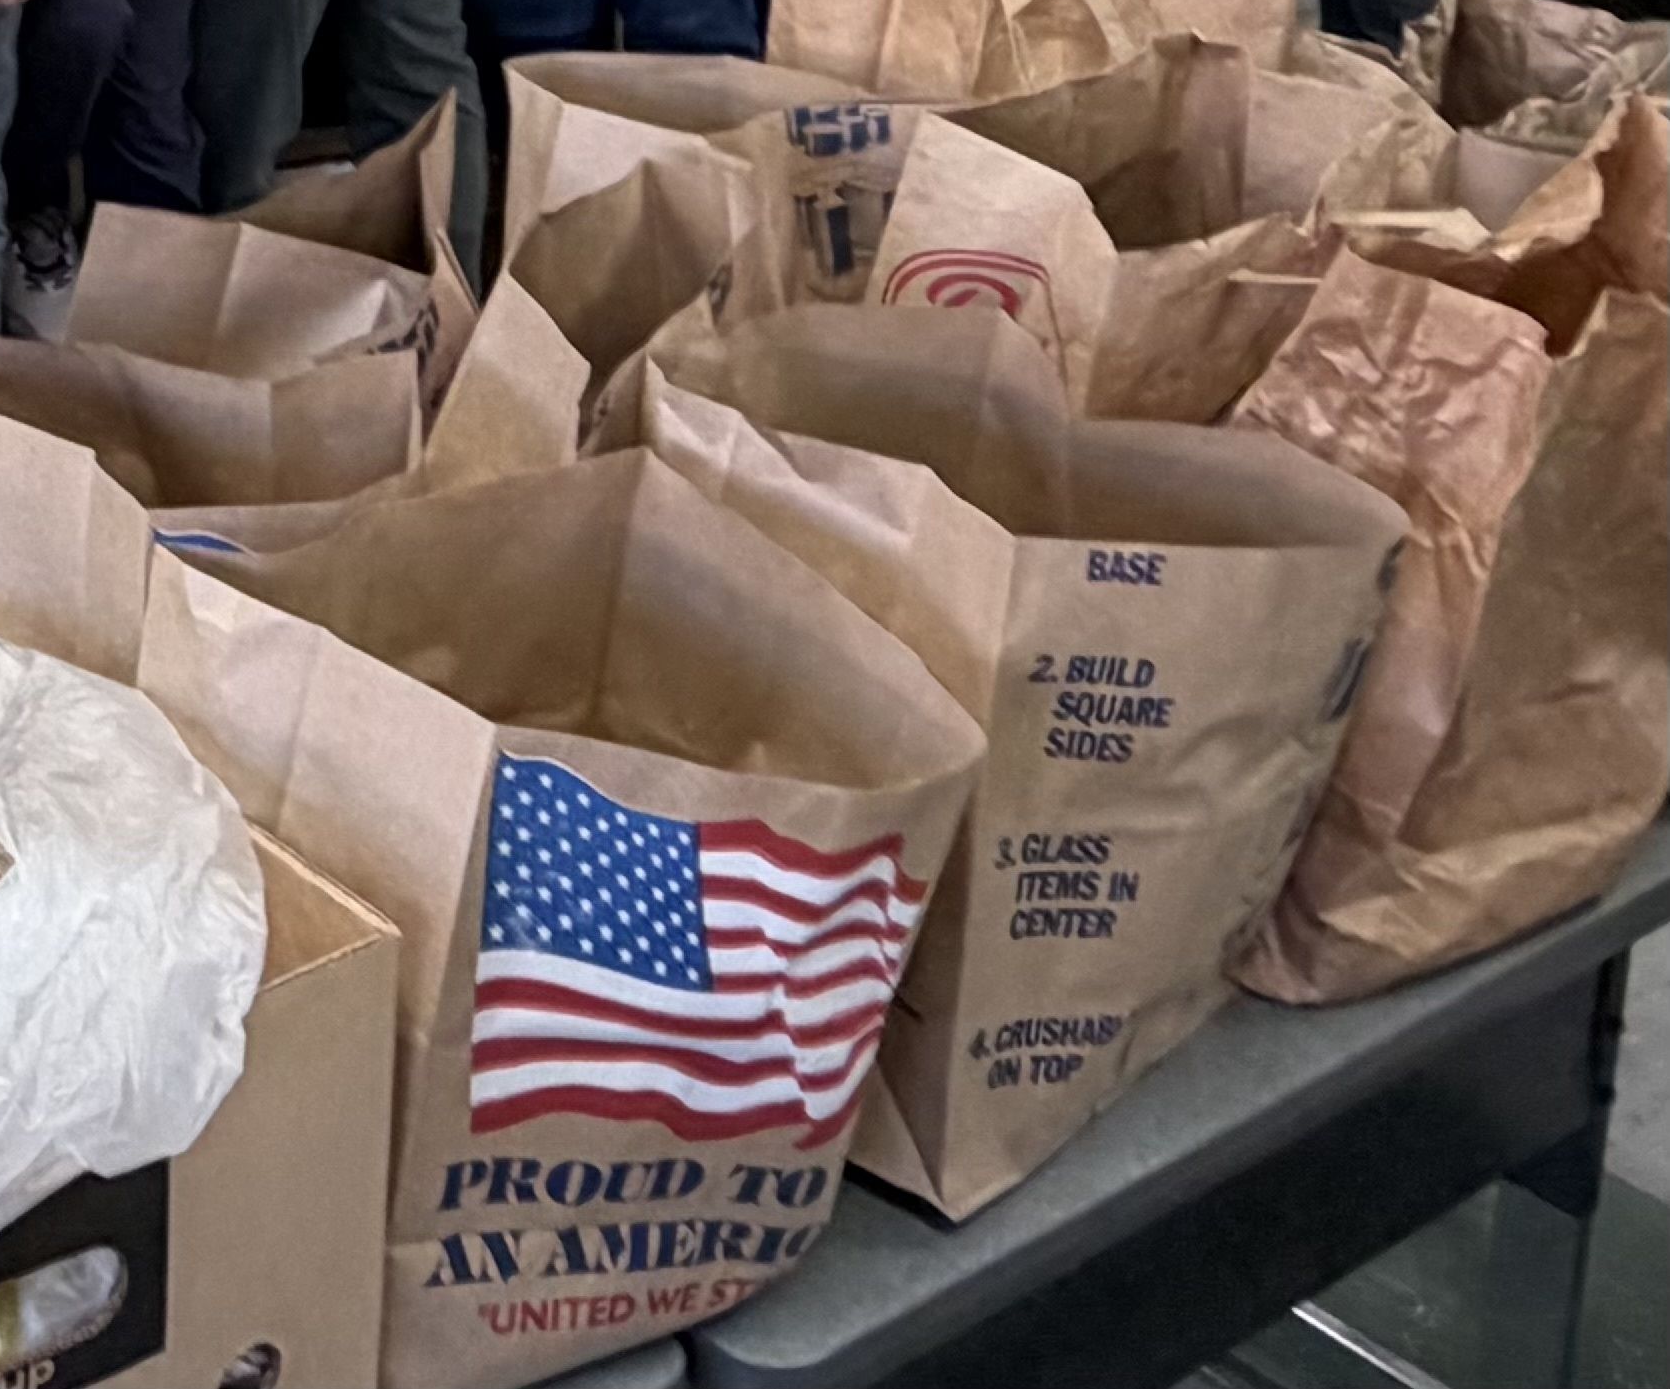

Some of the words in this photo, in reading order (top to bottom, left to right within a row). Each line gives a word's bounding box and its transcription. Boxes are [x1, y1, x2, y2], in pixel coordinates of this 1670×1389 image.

[1086, 549, 1167, 586] BASE
[1028, 654, 1057, 684] 2.
[1065, 655, 1156, 689] BUILD
[1051, 691, 1175, 728] SQUARE
[1043, 728, 1134, 764] SIDES
[1021, 833, 1114, 864] GLASS
[1015, 870, 1103, 903] ITEMS
[1108, 872, 1140, 902] IN
[1010, 908, 1118, 940] CENTER
[994, 1015, 1123, 1053] CRUSHAB
[987, 1058, 1021, 1089] ON
[1029, 1054, 1084, 1085] TOP
[438, 1156, 706, 1211] PROUD
[729, 1165, 828, 1207] TO
[424, 1230, 526, 1287] AN
[545, 1220, 821, 1276] AMERIC
[646, 1283, 701, 1314] WE
[711, 1277, 763, 1308] ST
